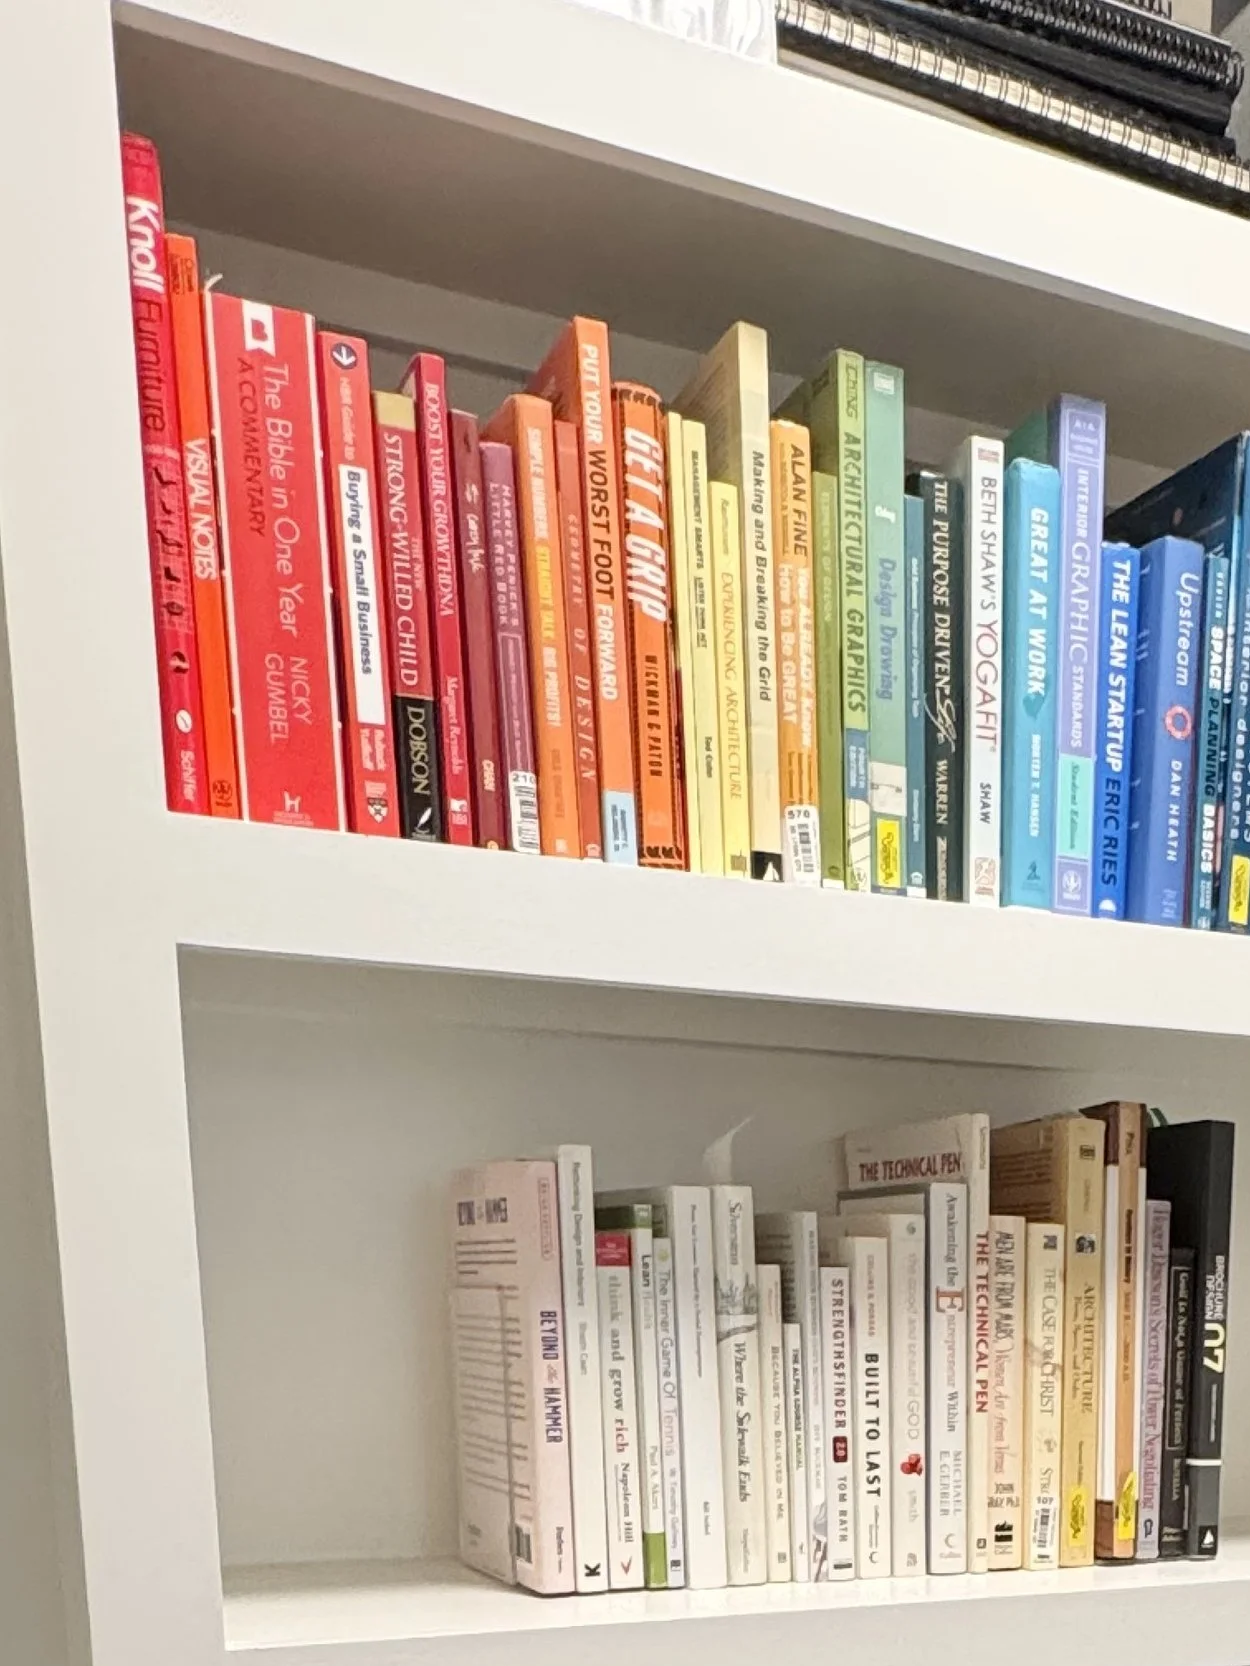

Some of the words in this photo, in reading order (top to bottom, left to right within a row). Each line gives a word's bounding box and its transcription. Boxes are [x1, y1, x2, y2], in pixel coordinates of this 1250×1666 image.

[126, 195, 165, 294] Knoll
[135, 299, 166, 433] Furniture
[264, 363, 290, 411] The
[580, 343, 600, 389] PUT
[845, 363, 859, 421] CHING
[582, 391, 604, 445] YOUR
[184, 438, 211, 509] VISUAL
[267, 417, 295, 480] Bible
[623, 427, 665, 504] GET
[790, 443, 806, 501] ALAN
[271, 485, 289, 508] in
[346, 470, 363, 530] Buying
[588, 449, 610, 537] WORST
[752, 450, 766, 515] Making
[980, 476, 998, 524] BETH
[1075, 467, 1090, 538] INTERIOR
[353, 533, 363, 543] a
[383, 433, 413, 612] STRONG-WILLED
[625, 501, 665, 530] A
[754, 514, 768, 551] and
[792, 502, 808, 559] FINE
[844, 431, 864, 599] ARCHITECTURAL
[192, 512, 218, 582] NOTES
[273, 516, 300, 577] One
[353, 549, 369, 596] Small
[568, 514, 586, 606] GEOMETRY
[592, 539, 615, 601] FOOT
[980, 529, 998, 612] SHAW'S
[1028, 506, 1049, 583] GREAT
[625, 533, 668, 623] GRIP
[755, 554, 770, 632] Breaking
[1028, 590, 1048, 621] AT
[1068, 541, 1091, 662] GRAPHIC
[1110, 558, 1131, 604] THE
[280, 583, 305, 637] Year
[356, 600, 372, 675] Business
[1109, 608, 1130, 669] LEAN
[1174, 571, 1199, 687] Upstream
[397, 617, 419, 687] CHILD
[573, 628, 588, 655] OF
[594, 604, 619, 701] FORWARD
[758, 635, 771, 664] the
[846, 608, 867, 715] GRAPHICS
[1026, 625, 1048, 698] WORK
[1208, 625, 1225, 692] SPACE
[265, 652, 290, 746] GUMBEL
[290, 656, 313, 726] NICKY
[759, 665, 773, 702] Grid
[975, 619, 999, 753] YOGAFIT
[1070, 664, 1085, 749] STANDARDS
[407, 705, 431, 795] DOBSON
[574, 674, 597, 780] DESIGN
[1104, 672, 1127, 774] STARTUP
[1204, 696, 1221, 798] PLANNING
[1103, 777, 1121, 832] ERIC
[1101, 836, 1118, 887] RIES
[1200, 802, 1217, 875] BASICS
[976, 1232, 990, 1271] THE
[608, 1275, 624, 1323] think
[658, 1269, 670, 1296] The
[1204, 1275, 1216, 1321] DESIGN
[1213, 1254, 1226, 1321] BROCHURE
[540, 1310, 560, 1361] BEYOND
[610, 1328, 626, 1362] and
[659, 1299, 672, 1333] Inner
[975, 1276, 990, 1374] TECHNICAL
[660, 1338, 674, 1379] Game
[734, 1341, 747, 1385] Where
[832, 1278, 848, 1430] STRENGTHSFINDER
[1082, 1282, 1096, 1414] ARCHITECTURE
[608, 1368, 625, 1412] grow
[662, 1382, 676, 1399] Of
[736, 1387, 748, 1407] the
[864, 1352, 880, 1408] BUILT
[975, 1379, 989, 1413] PEN
[543, 1387, 565, 1444] HAMMER
[614, 1417, 630, 1454] rich
[663, 1408, 678, 1457] Tennis
[736, 1409, 752, 1468] Sidewalk
[865, 1414, 881, 1441] TO
[620, 1461, 632, 1517] Napoleon
[738, 1469, 752, 1503] Ends
[837, 1475, 848, 1502] TOM
[865, 1450, 882, 1498] LAST
[624, 1521, 635, 1544] Hill
[838, 1509, 848, 1543] RATH
